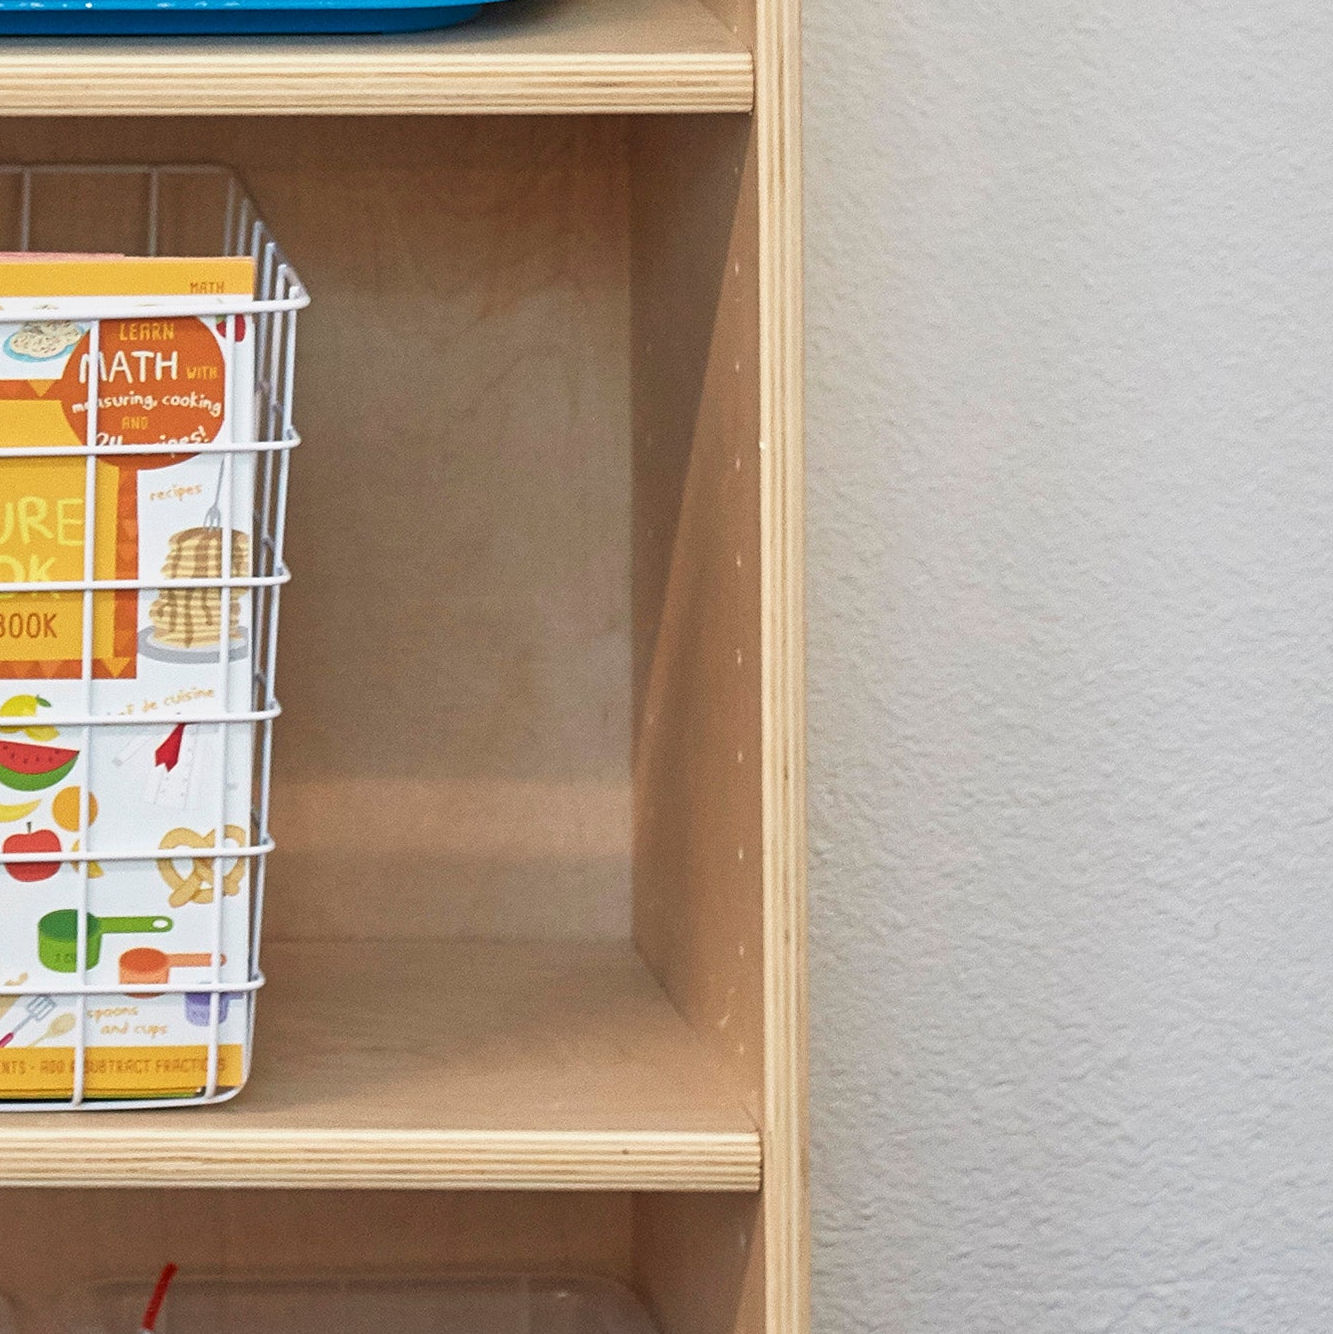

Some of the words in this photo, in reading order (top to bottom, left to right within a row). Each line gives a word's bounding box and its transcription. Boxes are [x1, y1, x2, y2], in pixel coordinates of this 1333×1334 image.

[190, 281, 225, 294] MATH
[119, 322, 175, 341] LEARN
[79, 350, 178, 384] MATH
[186, 366, 219, 380] WITH
[162, 391, 222, 418] cooking
[121, 415, 149, 430] AND
[149, 484, 203, 502] recipes
[155, 1058, 225, 1073] FRACTIOS
